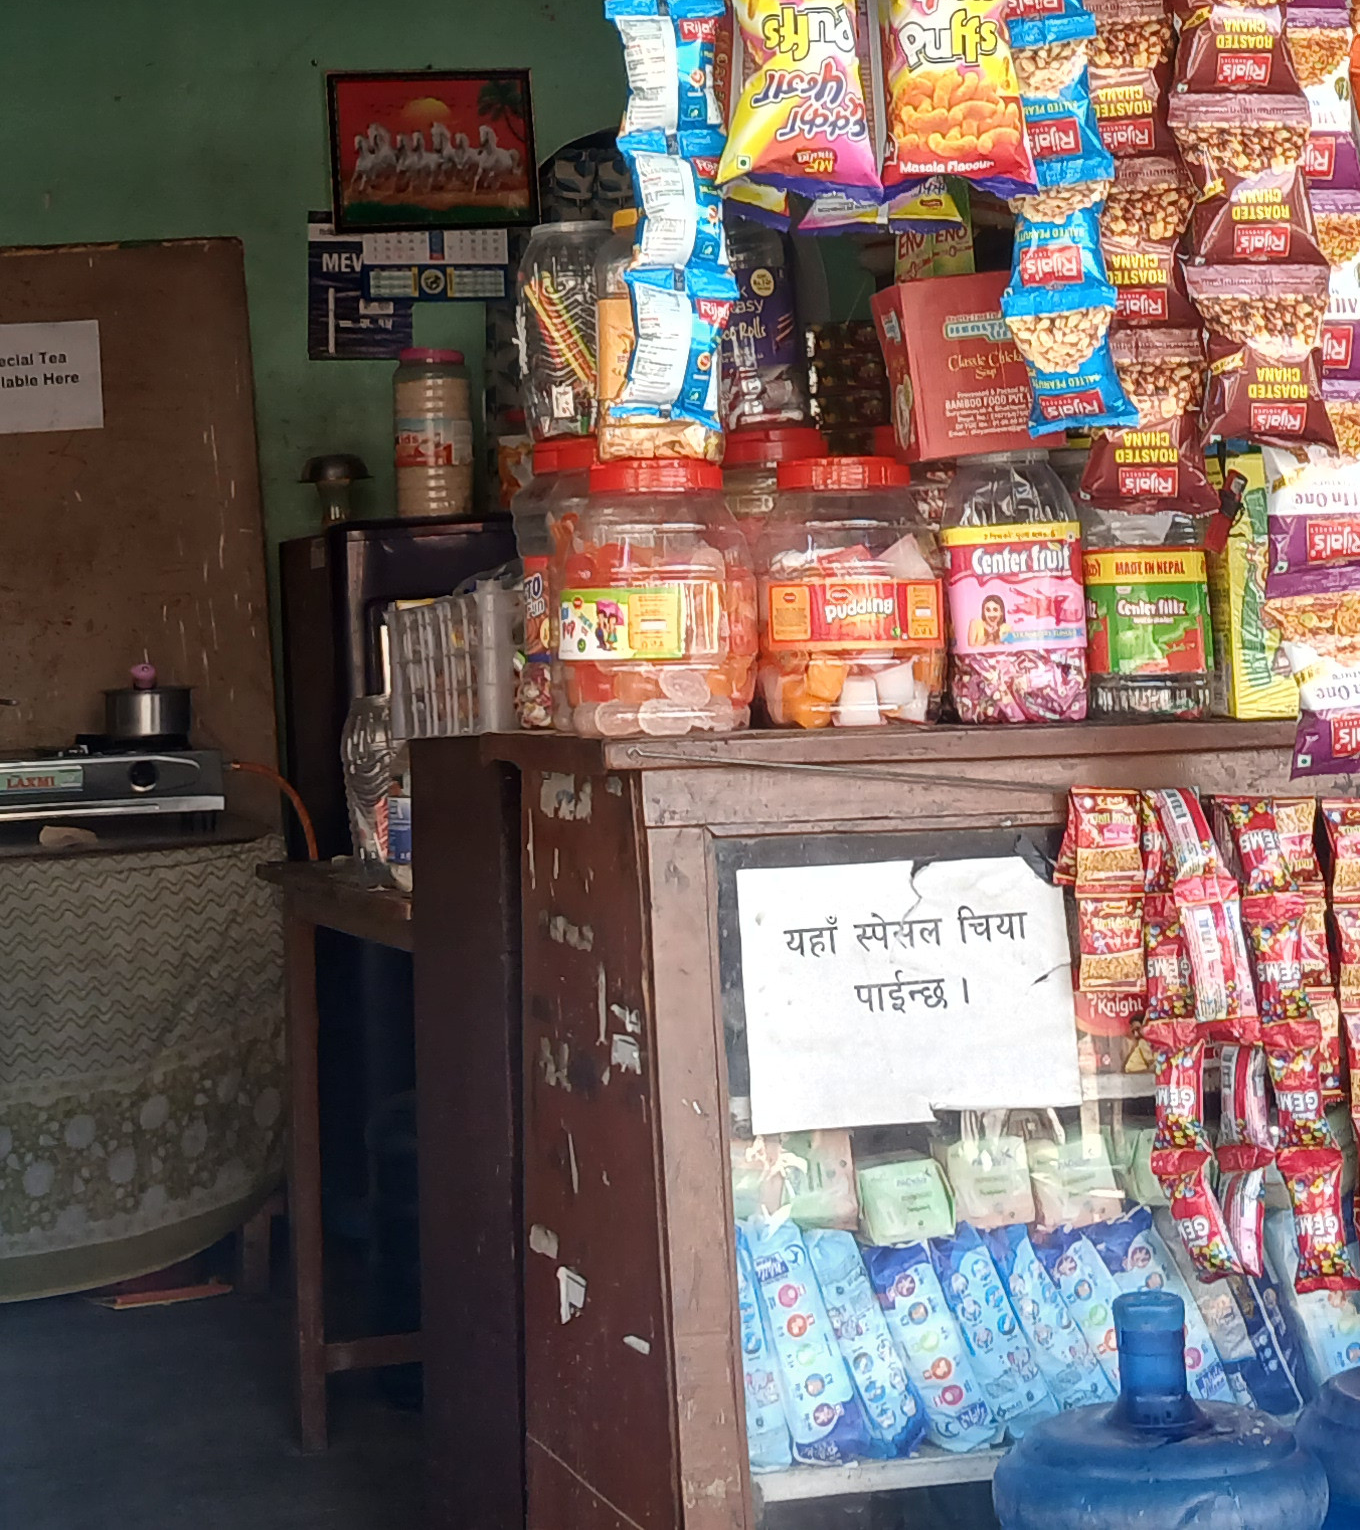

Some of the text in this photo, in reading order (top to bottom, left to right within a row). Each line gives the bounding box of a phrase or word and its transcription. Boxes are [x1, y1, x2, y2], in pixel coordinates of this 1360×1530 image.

[1222, 18, 1267, 33] CHANA
[1215, 34, 1274, 50] ROASTED
[899, 159, 946, 174] Masala
[1239, 187, 1283, 204] CHANA
[1231, 204, 1292, 220] ROASTED
[898, 233, 927, 260] ENO
[38, 350, 68, 365] Tea
[42, 371, 80, 385] Here
[1256, 367, 1301, 383] CHANA
[1248, 382, 1309, 400] ROASTED
[945, 397, 982, 410] BAMBOO
[1123, 431, 1170, 446] CHANA
[1115, 448, 1179, 463] ROASTED
[972, 541, 1072, 574] Center fruit
[1114, 560, 1186, 576] MADE IN NEPAL
[1117, 598, 1156, 617] Center
[783, 905, 1028, 958] यहाँ स्पेसल चिया
